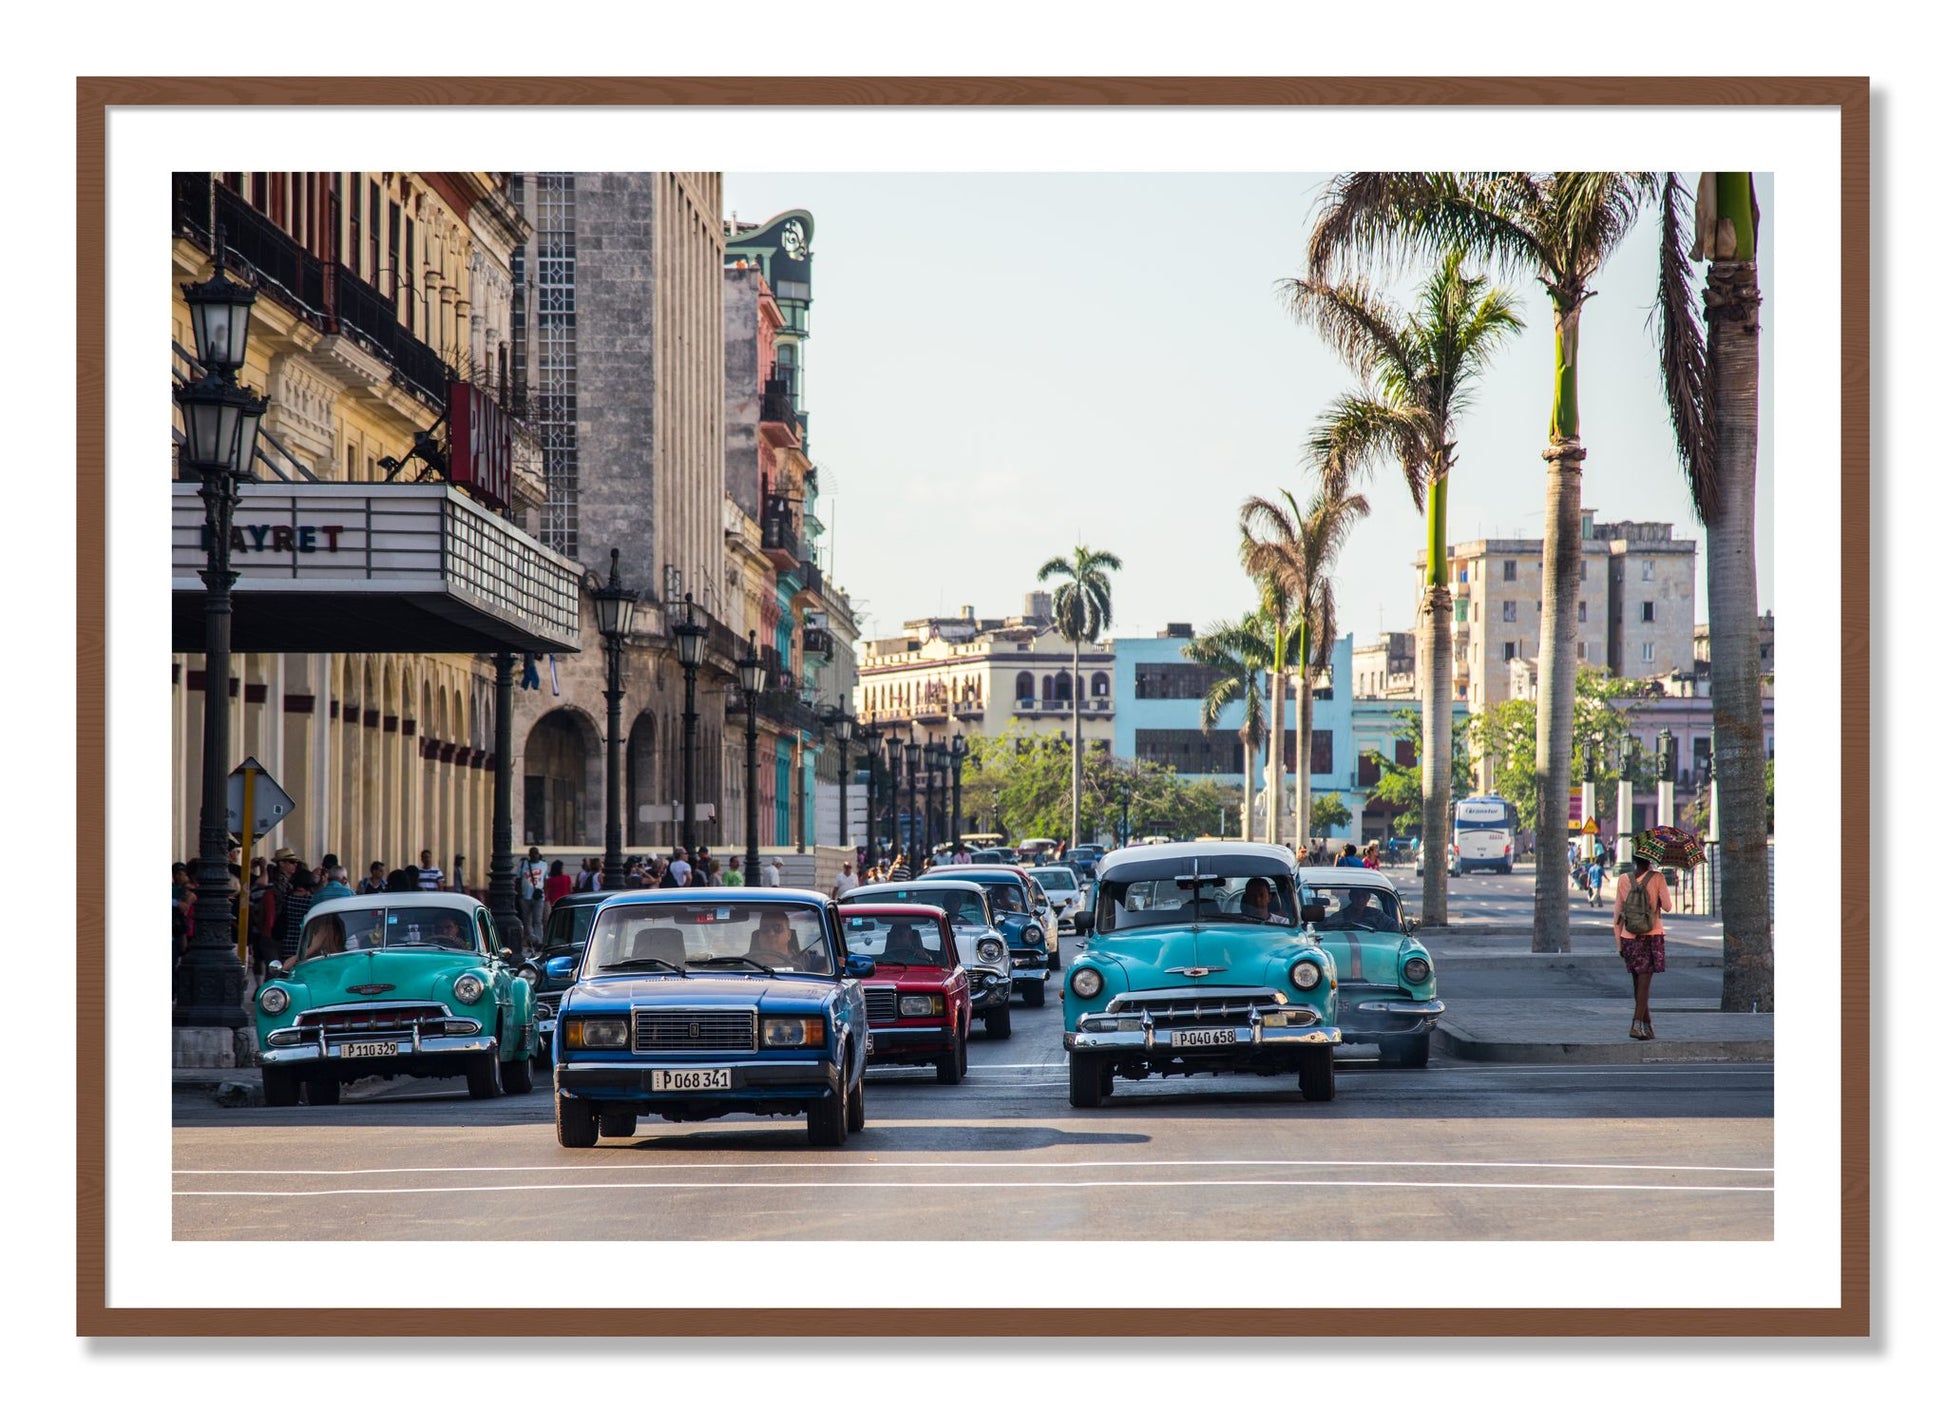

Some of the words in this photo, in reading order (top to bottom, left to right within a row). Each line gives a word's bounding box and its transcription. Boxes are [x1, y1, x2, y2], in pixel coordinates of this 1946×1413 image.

[1189, 1032, 1211, 1045] 040
[1213, 1031, 1234, 1044] 658
[356, 1045, 375, 1057] 110
[377, 1043, 396, 1056] 329
[663, 1072, 671, 1089] P
[674, 1072, 700, 1088] 068
[703, 1071, 728, 1087] 341
